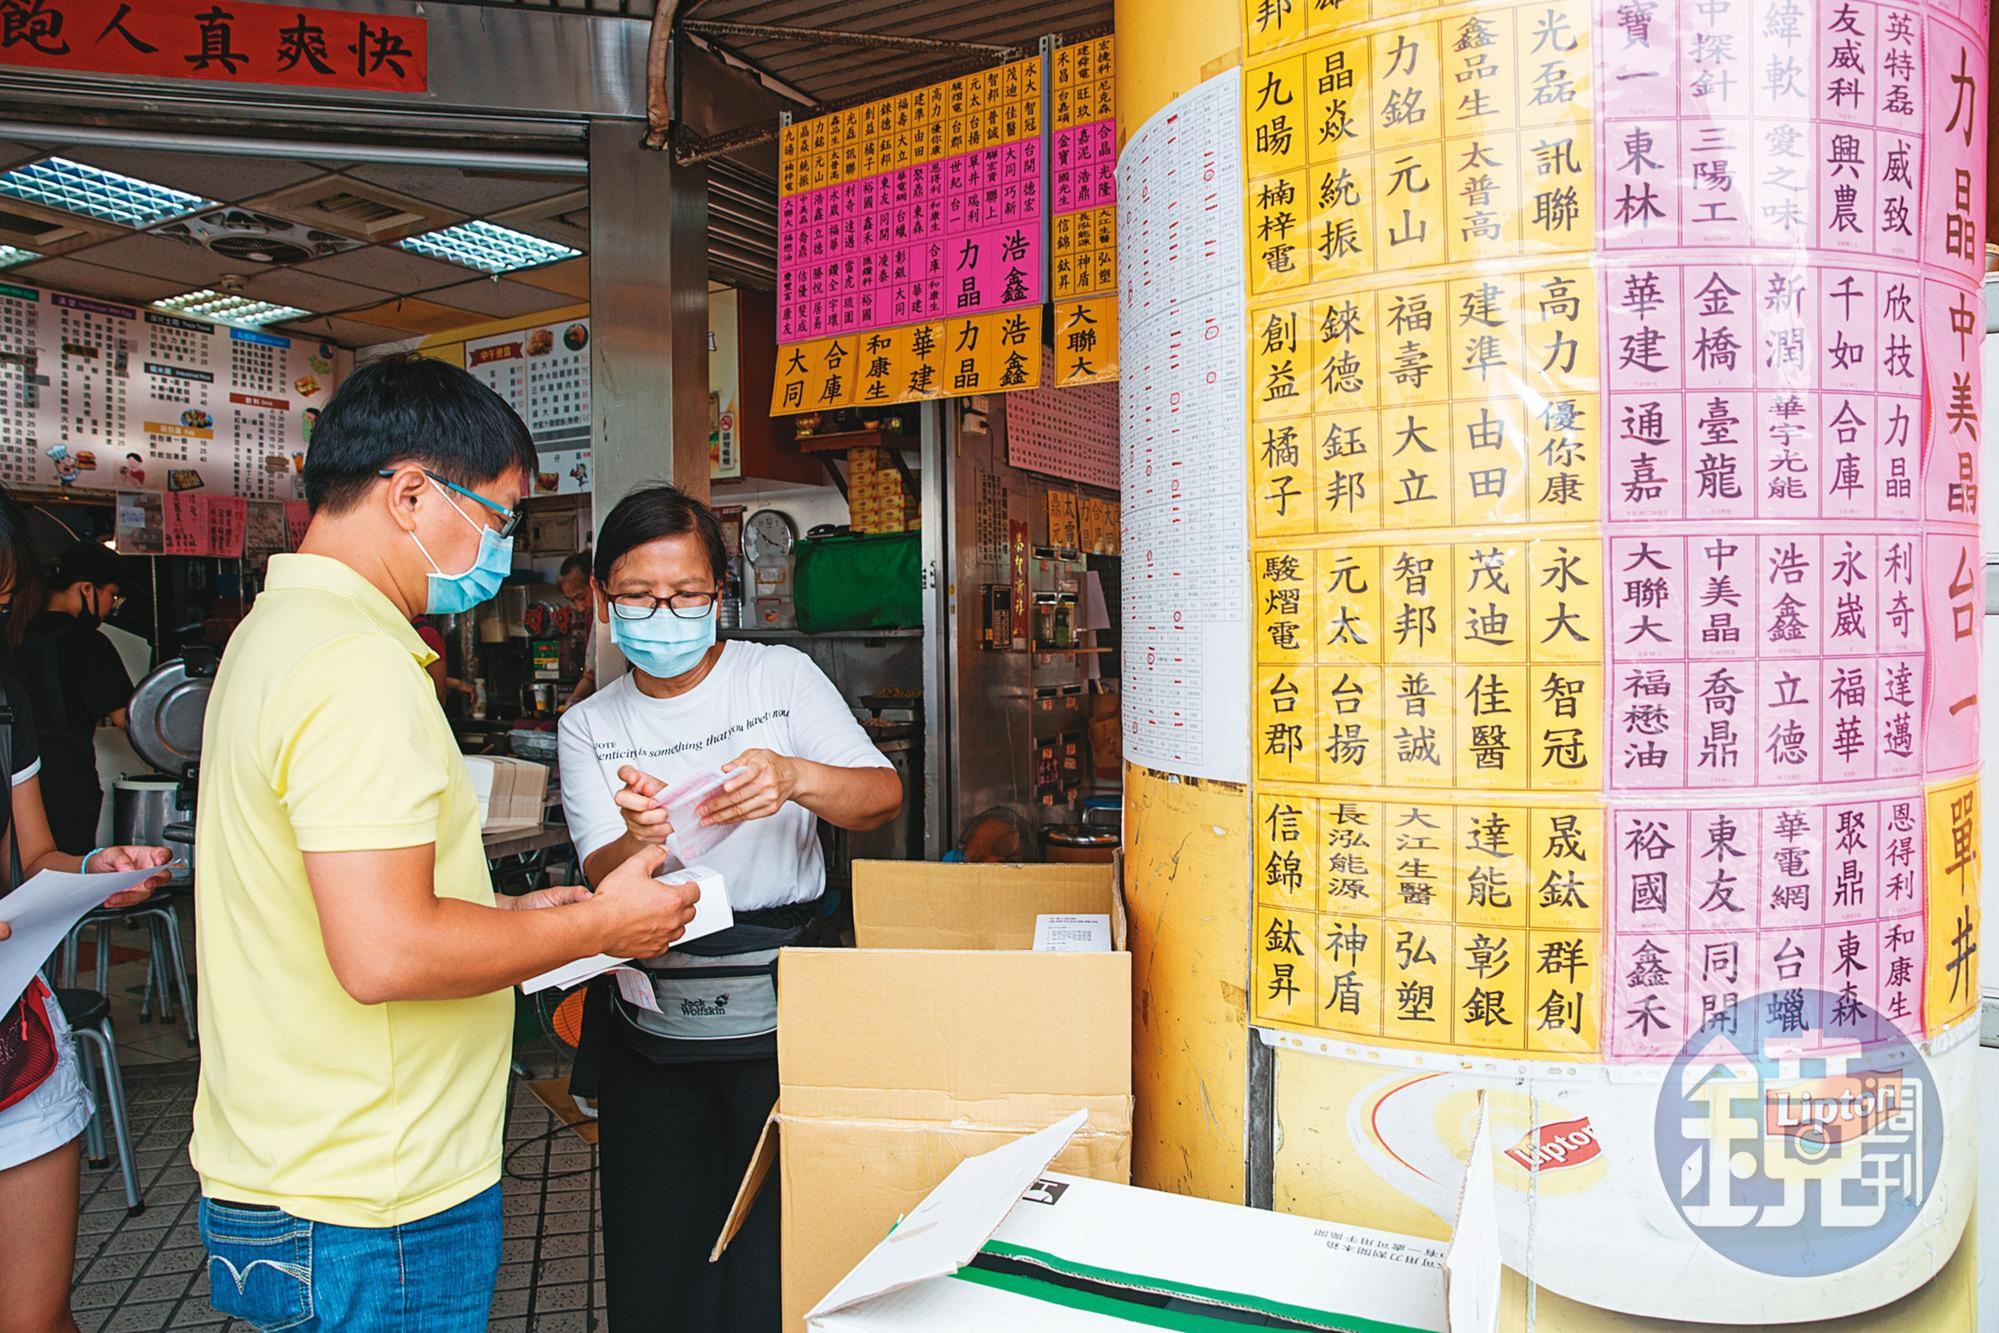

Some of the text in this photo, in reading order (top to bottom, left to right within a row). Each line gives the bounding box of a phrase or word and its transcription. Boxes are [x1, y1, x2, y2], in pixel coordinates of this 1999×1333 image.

[1380, 36, 1426, 128] 力銘
[1452, 16, 1501, 120] 鑫品生
[1527, 9, 1578, 106] 光磊
[1615, 0, 1660, 81] 寶一
[1688, 0, 1738, 102] 中探針
[1762, 0, 1806, 101] 緯軟
[1827, 4, 1865, 110] 友威科
[1881, 12, 1915, 117] 英特磊
[1255, 71, 1293, 156] 九暘
[1318, 50, 1358, 145] 晶焱
[1387, 156, 1429, 247] 元山
[1457, 142, 1504, 243] 太普高
[1530, 138, 1581, 232] 訊聯
[1613, 126, 1666, 230] 東林
[1691, 128, 1738, 225] 三陽工
[1762, 124, 1807, 231] 愛之味
[1827, 134, 1865, 234] 興農
[1881, 139, 1913, 236] 威致
[1945, 46, 1976, 264] 力晶
[1256, 179, 1296, 273] 楠梓電
[1317, 168, 1362, 261] 統振
[956, 239, 982, 308] 力晶
[1002, 230, 1030, 303] 浩鑫
[864, 334, 892, 400] 和康生
[908, 326, 935, 393] 華建
[954, 320, 980, 388] 力晶
[1000, 314, 1030, 387] 浩鑫
[1068, 305, 1098, 378] 大聯大
[1261, 311, 1300, 401] 創益
[1320, 300, 1364, 395] 錸德
[1387, 293, 1433, 389] 福壽
[1458, 281, 1509, 382] 建準
[1538, 276, 1580, 374] 高力
[1619, 271, 1669, 373] 華建
[1692, 271, 1742, 372] 金橋
[1765, 272, 1807, 372] 新潤
[1827, 277, 1863, 371] 千如
[1883, 283, 1915, 379] 欣技
[783, 349, 808, 408] 大同
[819, 341, 848, 404] 合庫
[1946, 292, 1979, 514] 中美晶
[1261, 426, 1302, 517] 橘子
[1323, 423, 1367, 513] 鈺邦
[1392, 415, 1437, 505] 大立
[1467, 408, 1507, 499] 由田
[1536, 398, 1586, 505] 優你康
[1620, 402, 1670, 503] 通嘉
[1695, 396, 1742, 500] 臺龍
[1767, 394, 1808, 500] 華宇光能
[1828, 400, 1867, 501] 合庫
[1884, 404, 1911, 499] 力晶
[1262, 554, 1304, 650] 駿熠電
[1327, 556, 1368, 645] 元太
[1393, 551, 1437, 648] 智邦
[1464, 547, 1514, 646] 茂迪
[1540, 546, 1590, 644] 永大
[1622, 542, 1672, 644] 大聯大
[1700, 538, 1742, 644] 中美晶
[1767, 542, 1810, 644] 浩鑫
[1830, 541, 1867, 640] 永崴
[1884, 541, 1915, 638] 利奇
[1949, 546, 1978, 717] 台一
[1264, 673, 1303, 763] 台郡
[1325, 673, 1369, 766] 台揚
[1393, 672, 1441, 767] 普誠
[1464, 673, 1512, 770] 佳醫
[1540, 672, 1588, 769] 智冠
[1622, 668, 1671, 769] 福懋油
[1697, 667, 1744, 769] 喬鼎
[1765, 670, 1808, 766] 立德
[1828, 667, 1865, 764] 福華
[1883, 662, 1915, 759] 達邁
[1265, 803, 1303, 895] 信錦
[1328, 803, 1370, 899] 長泓能源
[1396, 807, 1441, 905] 大江生醫
[1466, 812, 1514, 909] 達能
[1538, 814, 1589, 909] 晟鈦
[1624, 818, 1676, 915] 裕國
[1700, 815, 1746, 913] 東友
[1770, 810, 1811, 912] 華電網
[1833, 811, 1868, 907] 聚鼎
[1884, 802, 1916, 902] 恩得利
[1945, 790, 1977, 1004] 單井
[681, 999, 706, 1008] Jack
[1264, 917, 1304, 1006] 鈦昇
[1324, 923, 1368, 1016] 神盾
[1396, 930, 1437, 1023] 弘塑
[1463, 933, 1513, 1027] 彰銀
[1536, 938, 1588, 1035] 群創
[1625, 939, 1671, 1038] 鑫禾
[1700, 941, 1739, 1035] 同開
[1765, 937, 1809, 1034] 台蠟
[1829, 930, 1868, 1028] 東森
[1884, 925, 1915, 1020] 和康生
[681, 1007, 726, 1016] Wolfskin
[1776, 1085, 1896, 1136] Lipton
